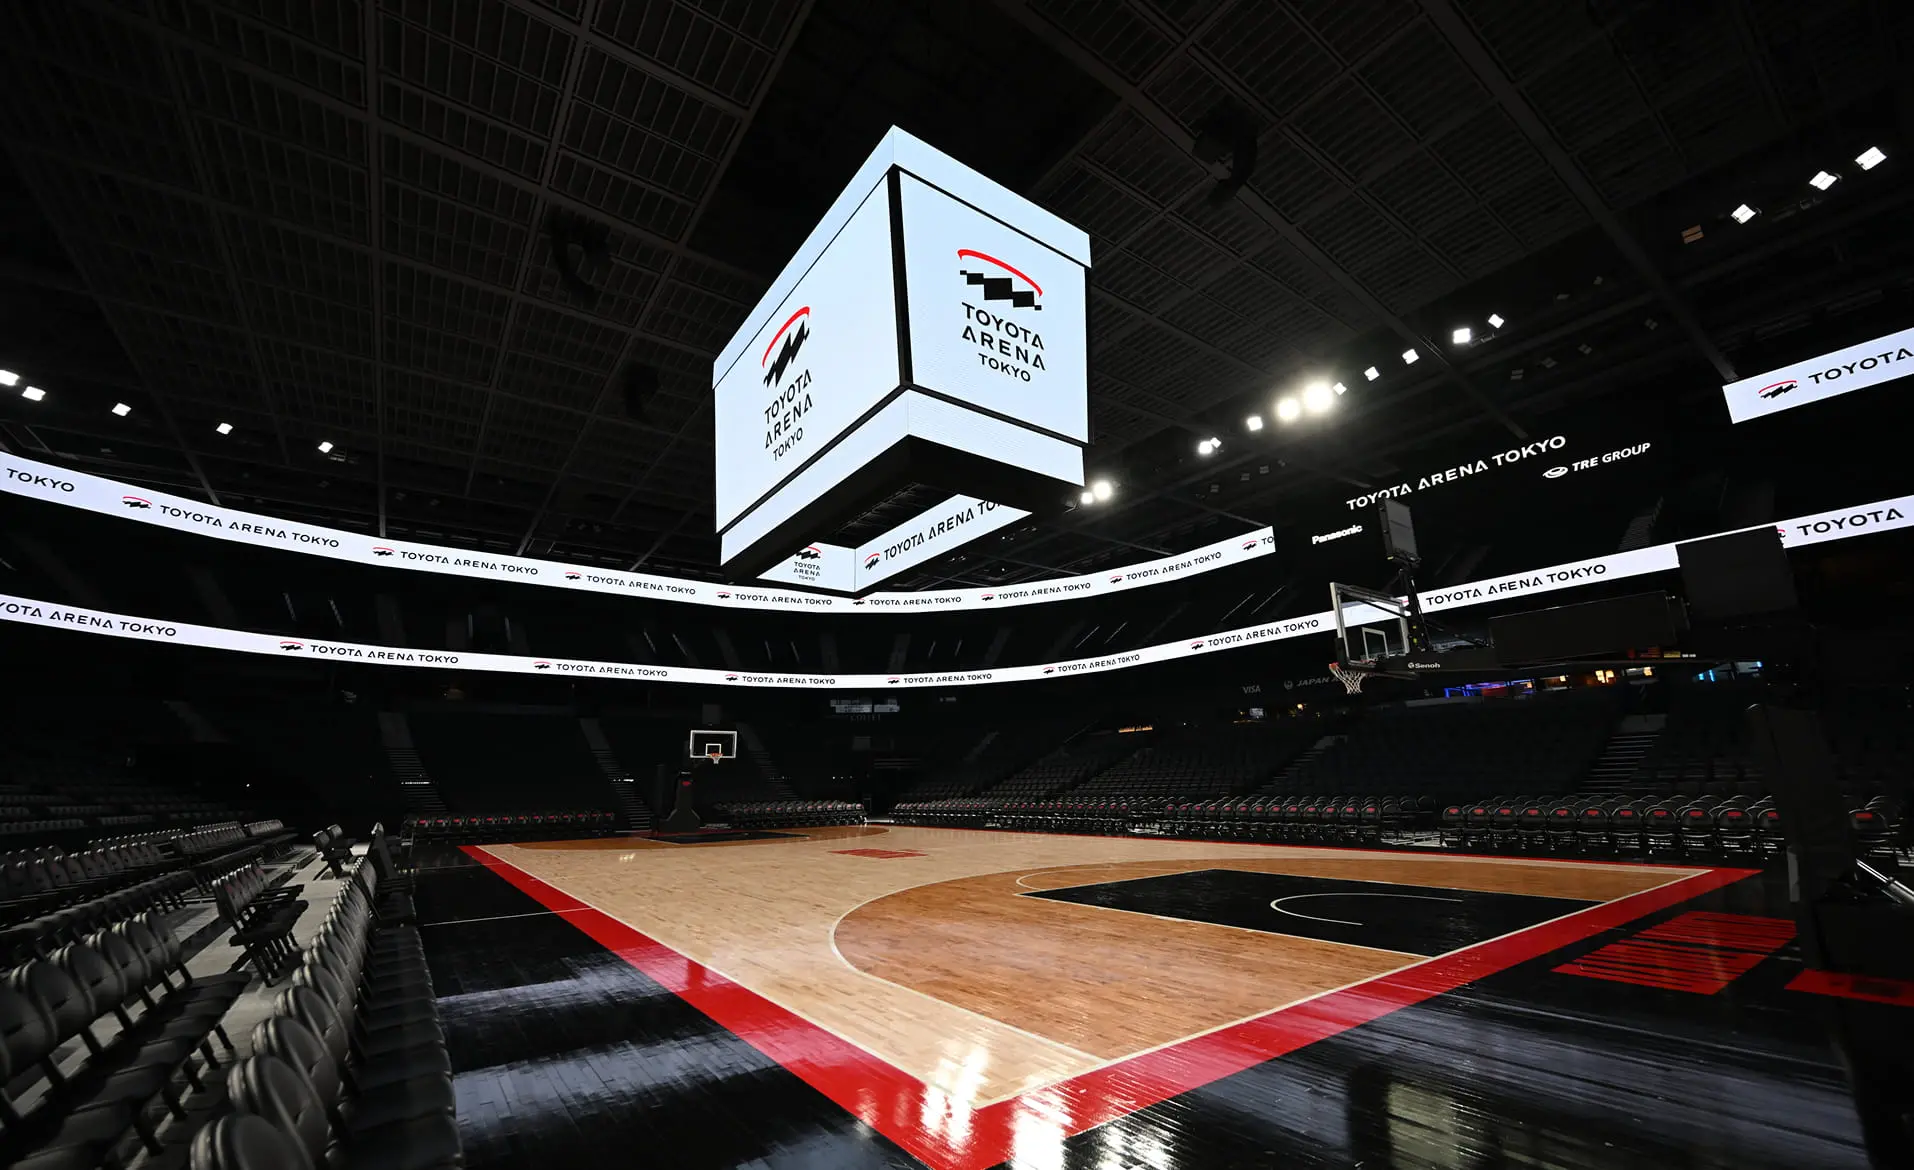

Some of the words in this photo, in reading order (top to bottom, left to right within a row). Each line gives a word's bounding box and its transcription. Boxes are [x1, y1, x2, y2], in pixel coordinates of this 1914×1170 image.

[961, 301, 1045, 350] TOYOTA
[961, 325, 1046, 371] ARENA
[978, 353, 1031, 382] TOKYO
[1808, 348, 1913, 384] TOYOTA
[764, 368, 812, 425] TOYOTA
[765, 393, 813, 448] ARENA
[773, 427, 804, 461] TOKYO
[1417, 460, 1489, 490] ARENA
[1492, 435, 1566, 466] TOKYO
[1572, 457, 1599, 472] TRE
[1602, 443, 1651, 464] GROUP
[5, 468, 75, 492] TOKYO
[160, 504, 223, 528] TOYOTA
[228, 521, 288, 539] ARENA
[291, 532, 340, 548] TOKYO
[884, 532, 925, 560] TOYOTA
[928, 508, 974, 540] ARENA
[1796, 506, 1904, 537] TOYOTA
[1311, 524, 1363, 546] Panasonic
[400, 550, 450, 564] TOYOTA
[454, 558, 498, 570] ARENA
[500, 564, 539, 575] TOKYO
[794, 562, 820, 570] TOYOTA
[794, 568, 820, 576] ARENA
[1125, 568, 1159, 581] TOYOTA
[1161, 560, 1193, 575] ARENA
[1193, 551, 1222, 566] TOKYO
[586, 574, 626, 586] TOYOTA
[628, 581, 664, 591] ARENA
[666, 585, 696, 595] TOKYO
[998, 589, 1029, 600] TOYOTA
[1031, 585, 1062, 596] ARENA
[1063, 582, 1091, 592] TOKYO
[1425, 586, 1483, 607] TOYOTA
[1547, 563, 1607, 585] TOKYO
[735, 593, 770, 603] TOYOTA
[771, 596, 803, 604] ARENA
[804, 597, 832, 606] TOKYO
[869, 598, 902, 606] TOYOTA
[903, 597, 933, 605] ARENA
[934, 596, 962, 604] TOKYO
[48, 610, 114, 629] ARENA
[119, 621, 177, 637] TOKYO
[1207, 634, 1243, 647] TOYOTA
[1244, 626, 1282, 642] ARENA
[1282, 618, 1319, 633] TOKYO
[310, 643, 363, 657] TOYOTA
[367, 650, 415, 662] ARENA
[418, 653, 459, 665] TOKYO
[1057, 663, 1087, 673] TOYOTA
[1089, 658, 1116, 669] ARENA
[1117, 653, 1140, 665] TOKYO
[556, 663, 596, 674] TOYOTA
[599, 666, 635, 675] ARENA
[636, 668, 668, 678] TOKYO
[742, 675, 775, 683] TOYOTA
[776, 676, 807, 684] ARENA
[807, 677, 836, 685] TOKYO
[903, 676, 935, 684] TOYOTA
[936, 673, 966, 682] ARENA
[966, 672, 993, 681] TOKYO
[1296, 677, 1330, 687] JAPAN
[1242, 685, 1261, 694] VISA
